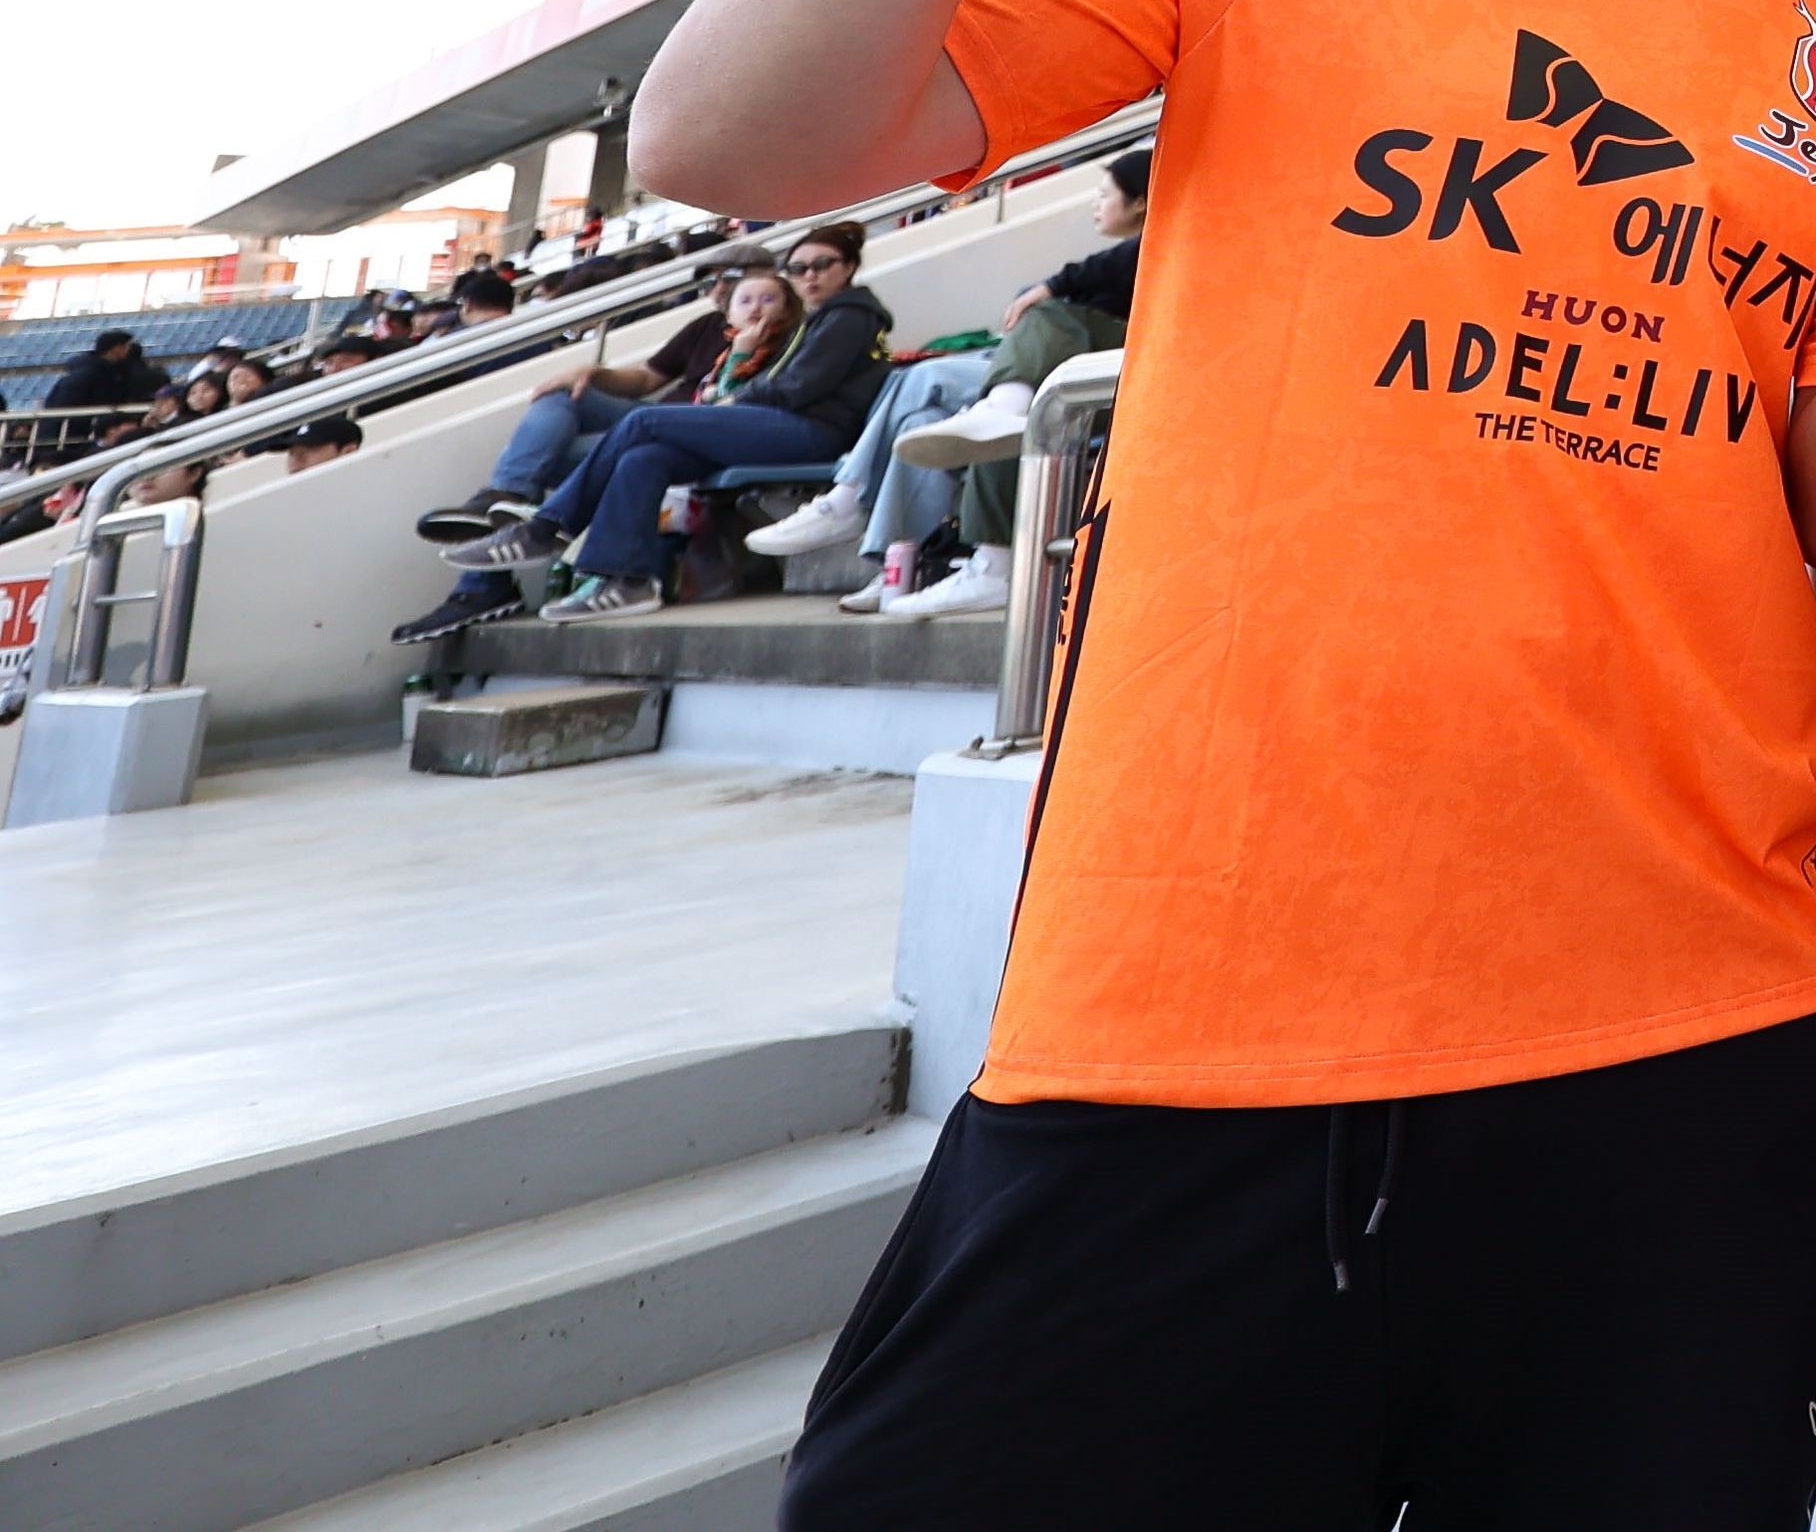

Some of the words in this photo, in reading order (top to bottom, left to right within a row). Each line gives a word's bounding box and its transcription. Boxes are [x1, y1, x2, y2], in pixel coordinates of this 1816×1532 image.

[1331, 127, 1549, 255] SK
[1521, 289, 1665, 343] HUON
[1374, 319, 1756, 444] ADEL:LIV
[1474, 412, 1532, 442] THE
[1540, 419, 1661, 472] TERRACE
